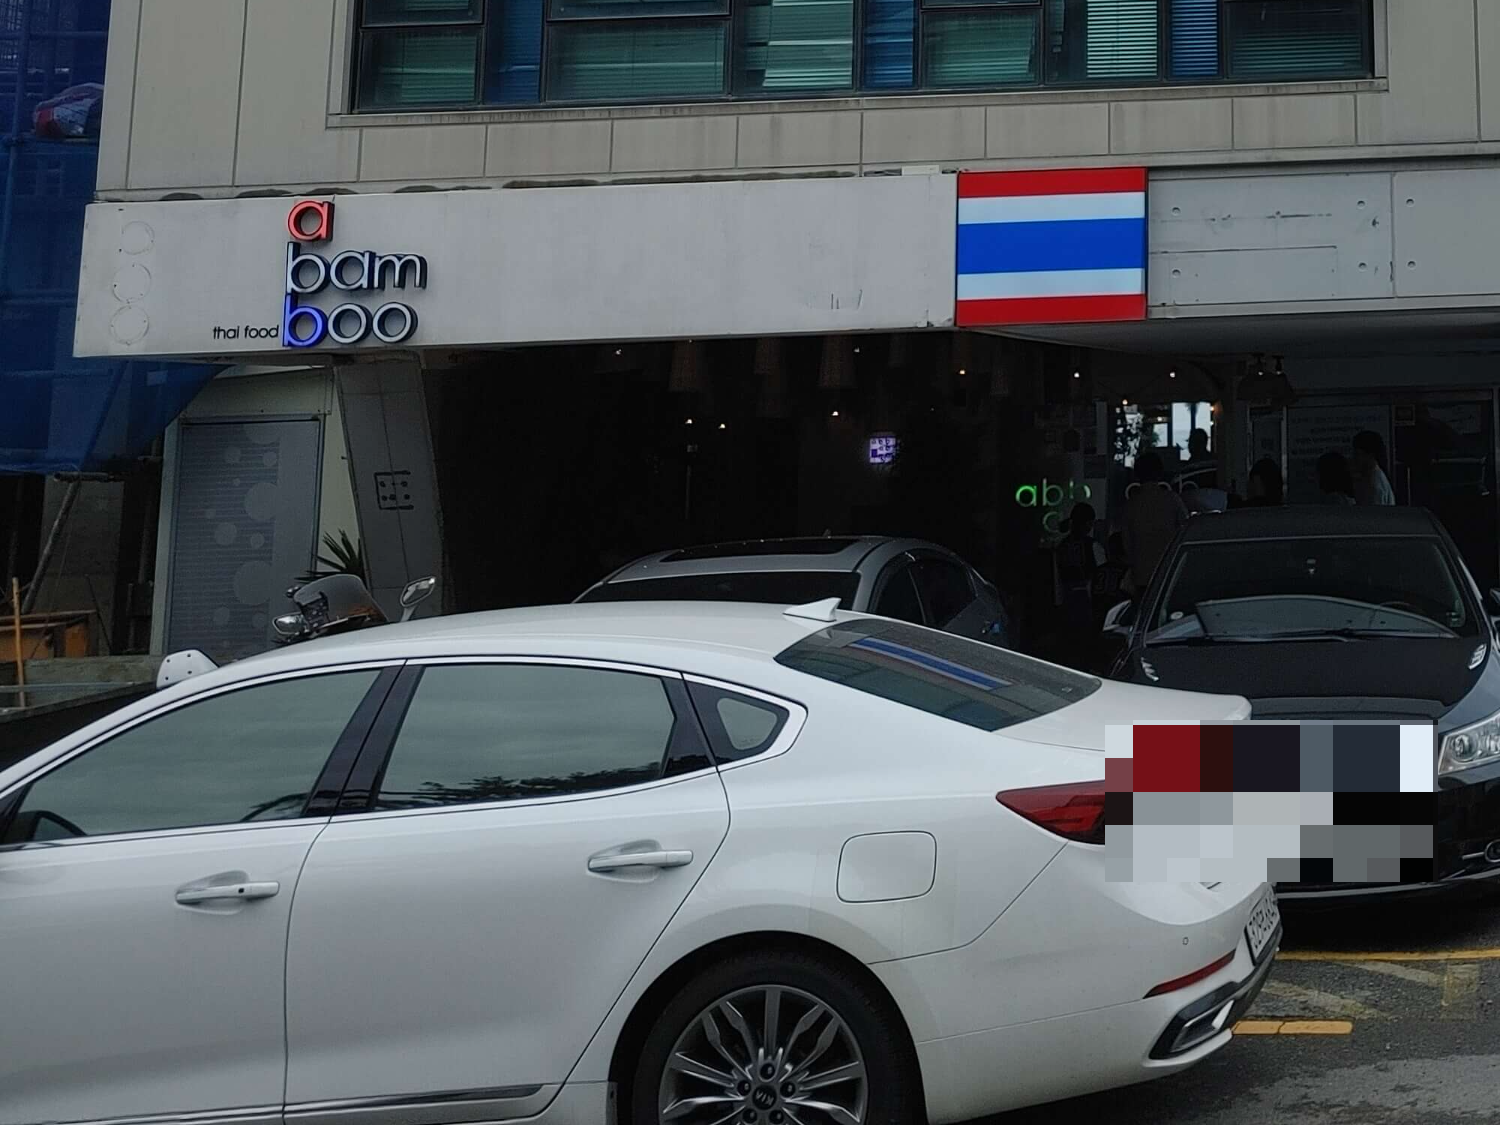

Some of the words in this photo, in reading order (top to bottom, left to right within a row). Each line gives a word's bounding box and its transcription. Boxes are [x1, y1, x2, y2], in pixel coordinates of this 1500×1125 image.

[288, 200, 335, 242] a
[286, 241, 428, 294] bam
[212, 325, 240, 340] thai
[244, 324, 280, 339] food
[282, 292, 419, 348] boo
